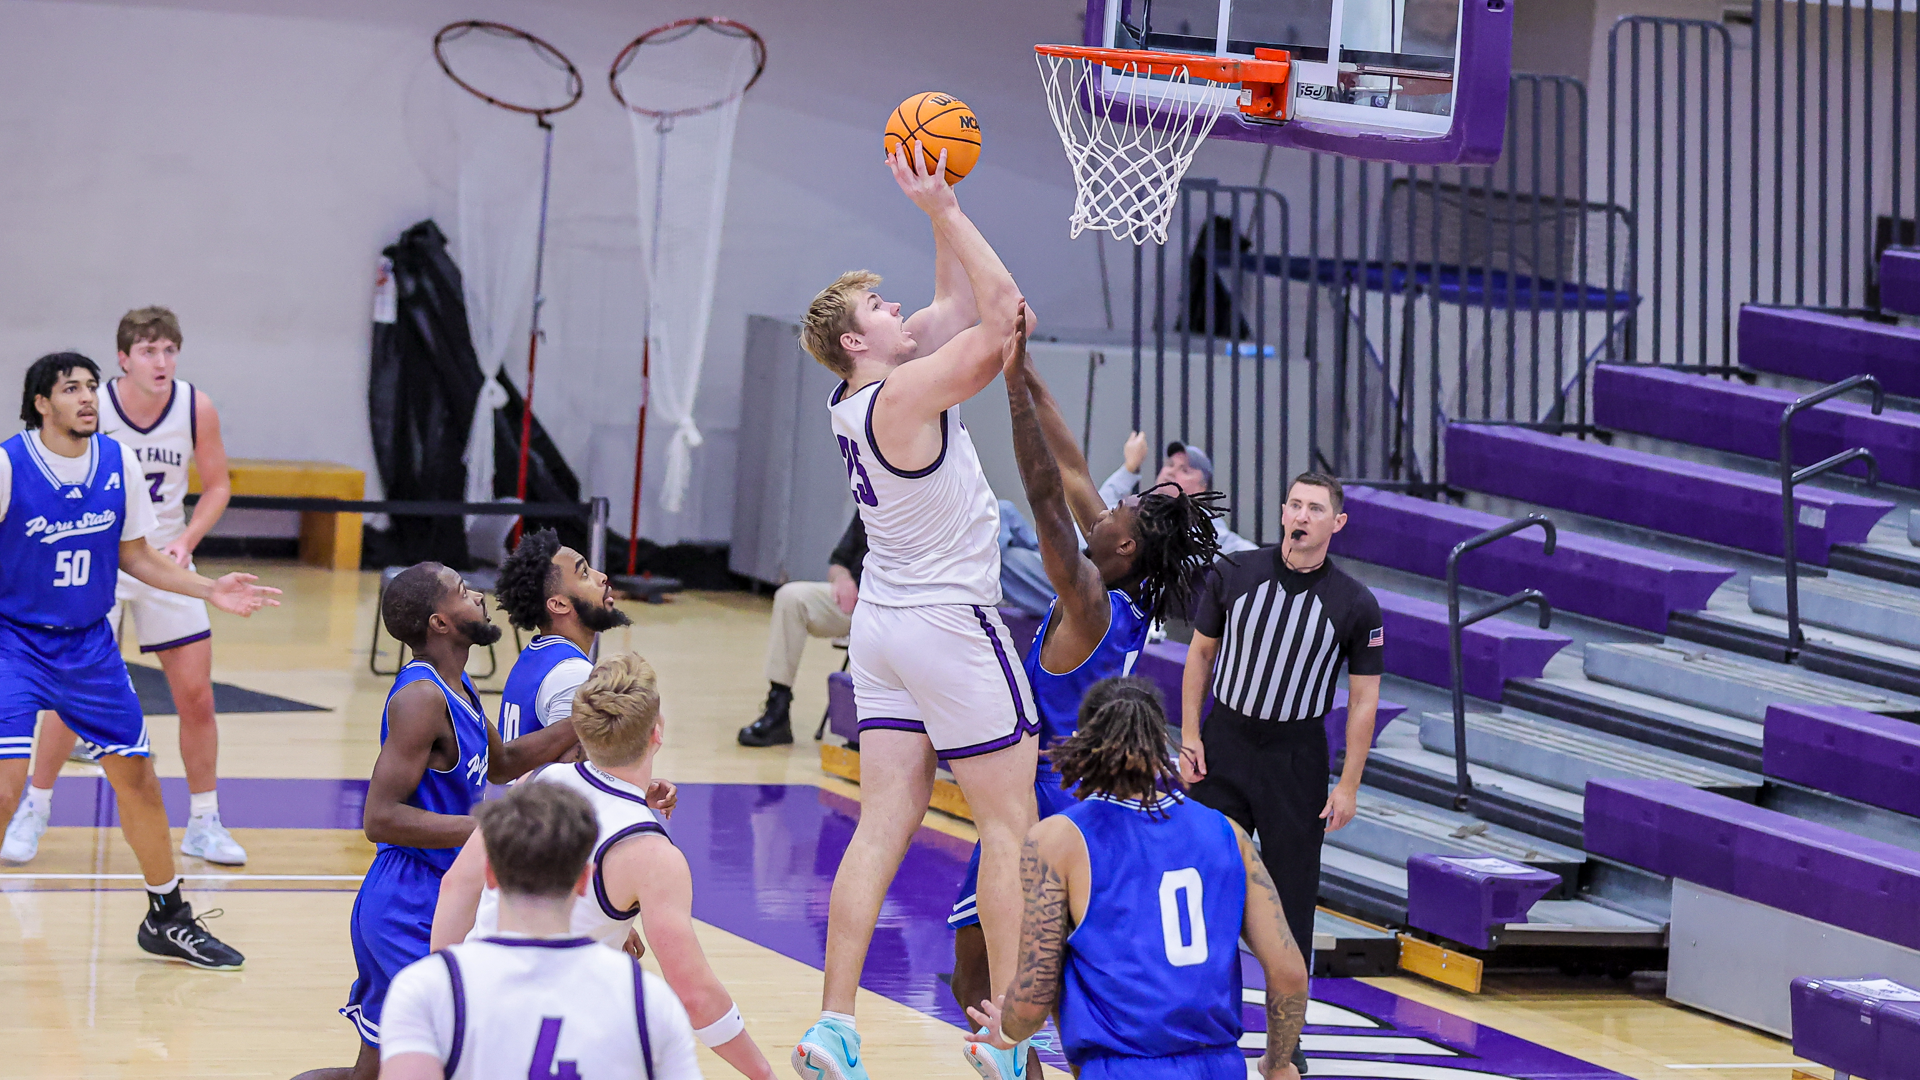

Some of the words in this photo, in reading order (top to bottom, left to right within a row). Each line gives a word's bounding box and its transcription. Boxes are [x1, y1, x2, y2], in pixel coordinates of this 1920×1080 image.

[148, 447, 181, 467] FALLS
[837, 434, 878, 507] 25
[25, 515, 74, 537] Peru
[76, 509, 117, 529] State
[53, 549, 91, 587] 50
[1158, 867, 1209, 967] 0
[528, 1017, 582, 1080] 4
